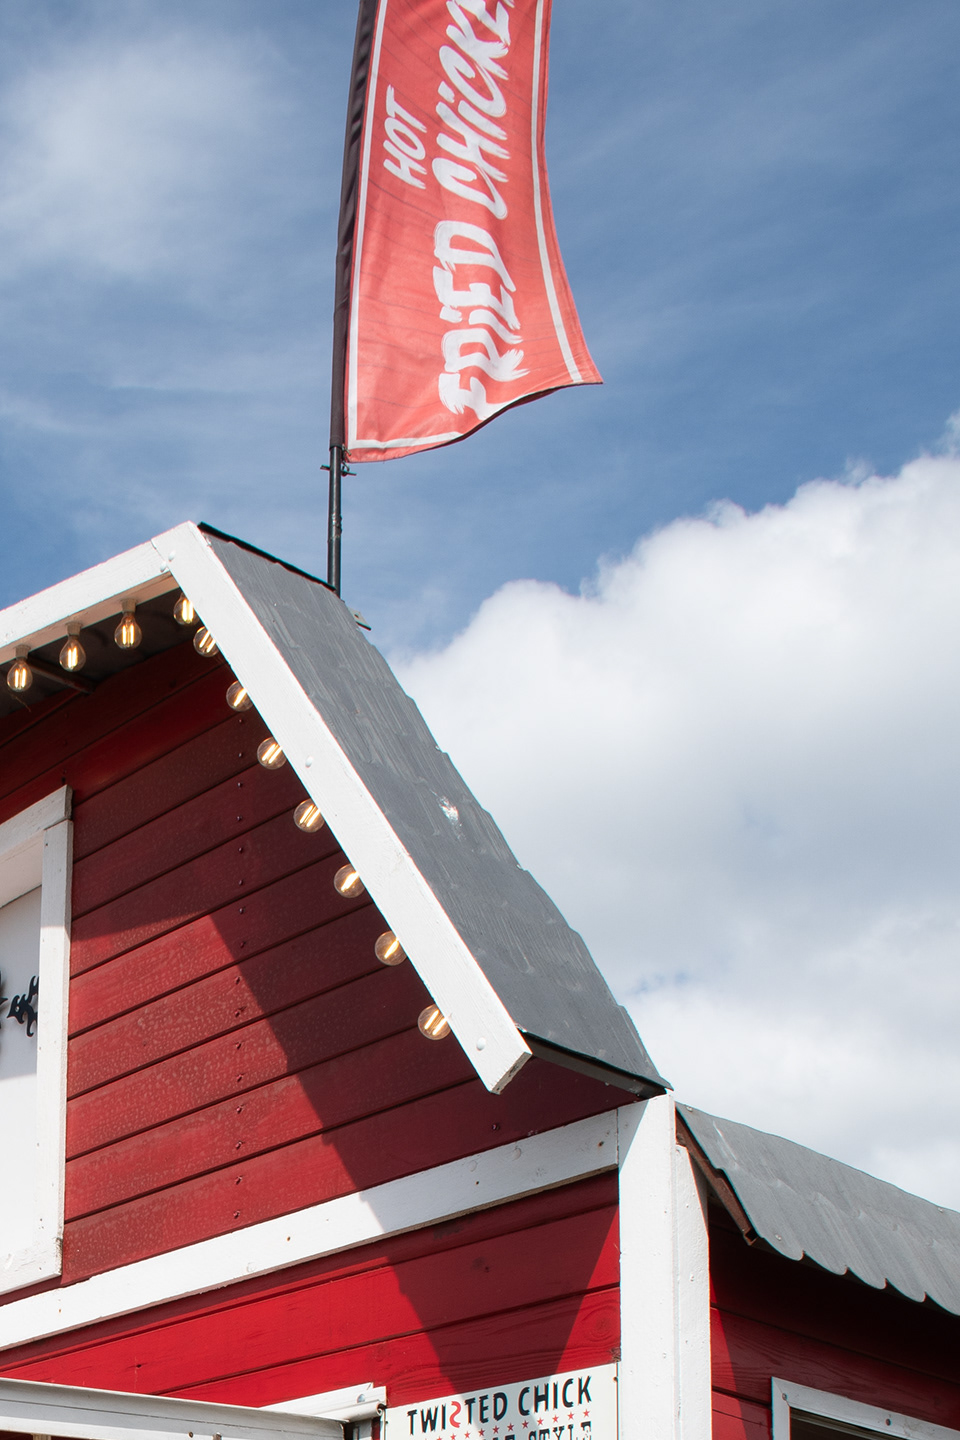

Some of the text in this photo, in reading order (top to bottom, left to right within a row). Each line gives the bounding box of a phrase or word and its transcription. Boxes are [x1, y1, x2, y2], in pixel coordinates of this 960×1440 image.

[383, 85, 427, 189] HOT
[432, 0, 513, 220] CHICKE
[408, 1376, 591, 1434] TWISTED CHICK
